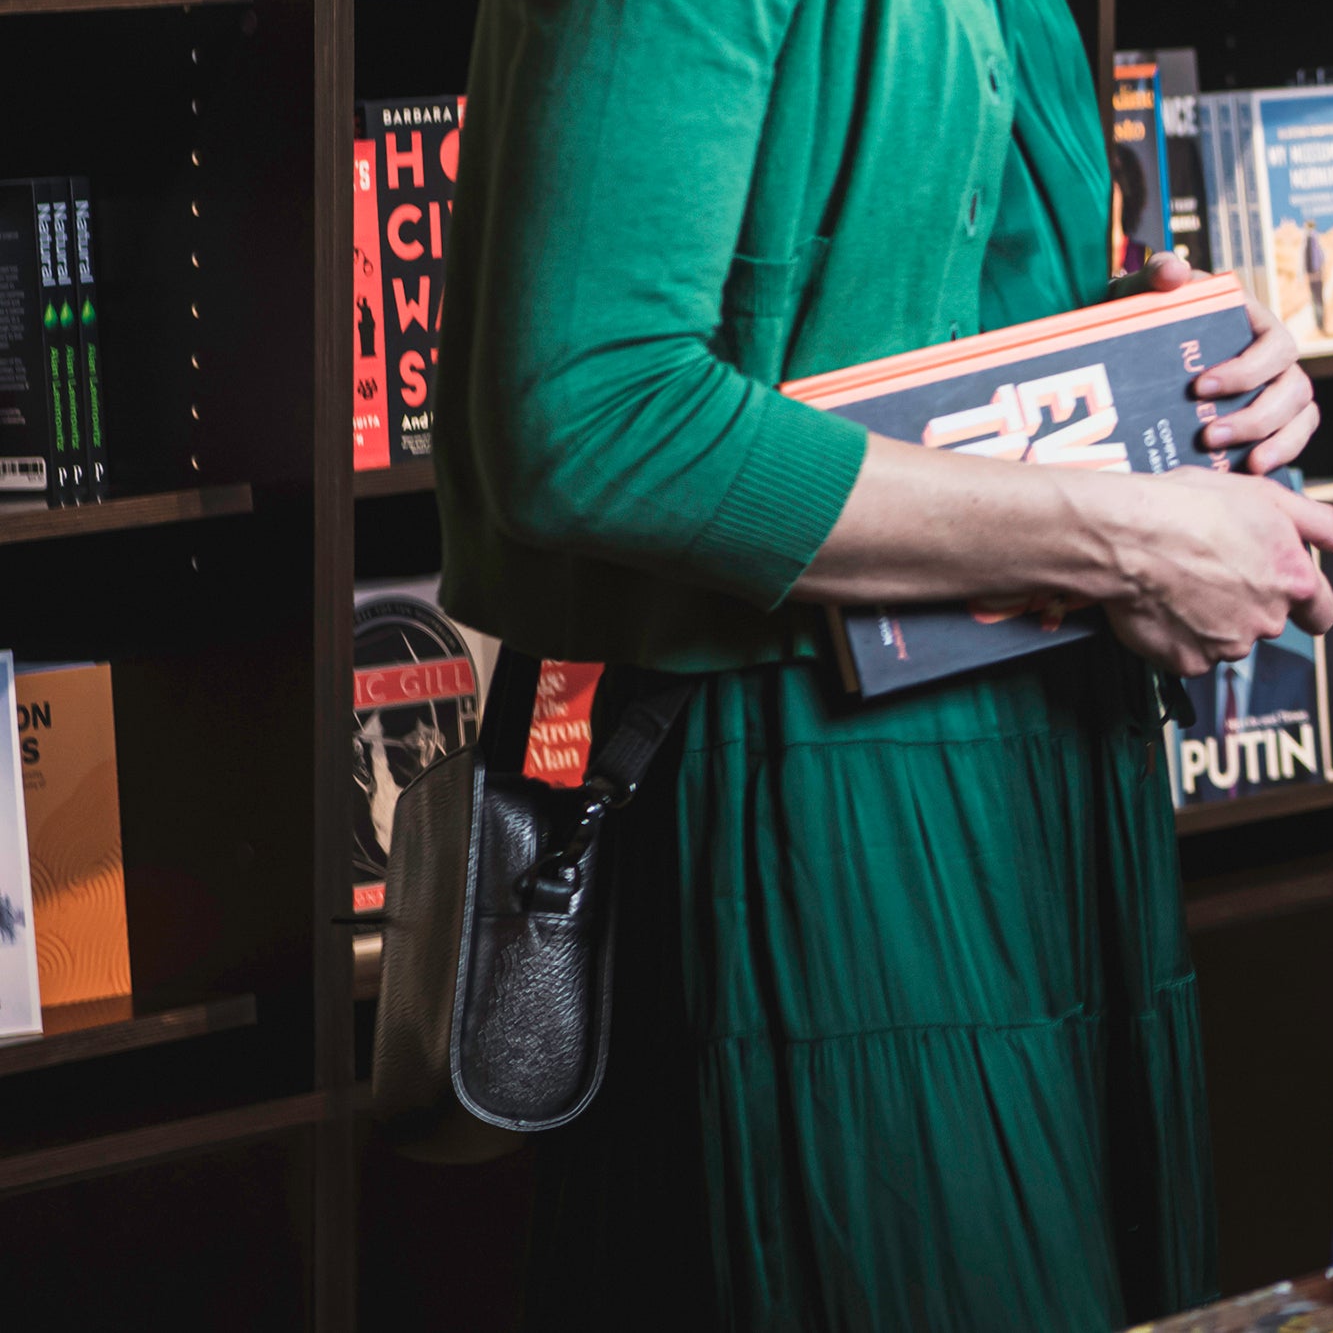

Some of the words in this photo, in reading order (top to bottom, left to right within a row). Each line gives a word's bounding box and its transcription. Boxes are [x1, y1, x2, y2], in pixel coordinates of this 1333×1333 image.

[382, 106, 452, 127] BARBARA
[36, 202, 57, 288] Natural
[53, 201, 73, 287] Natural
[74, 199, 95, 284] Natural
[1142, 426, 1158, 448] TO
[1156, 417, 1181, 469] COMPLE
[399, 665, 468, 700] GILL
[1180, 722, 1317, 794] PUTIN
